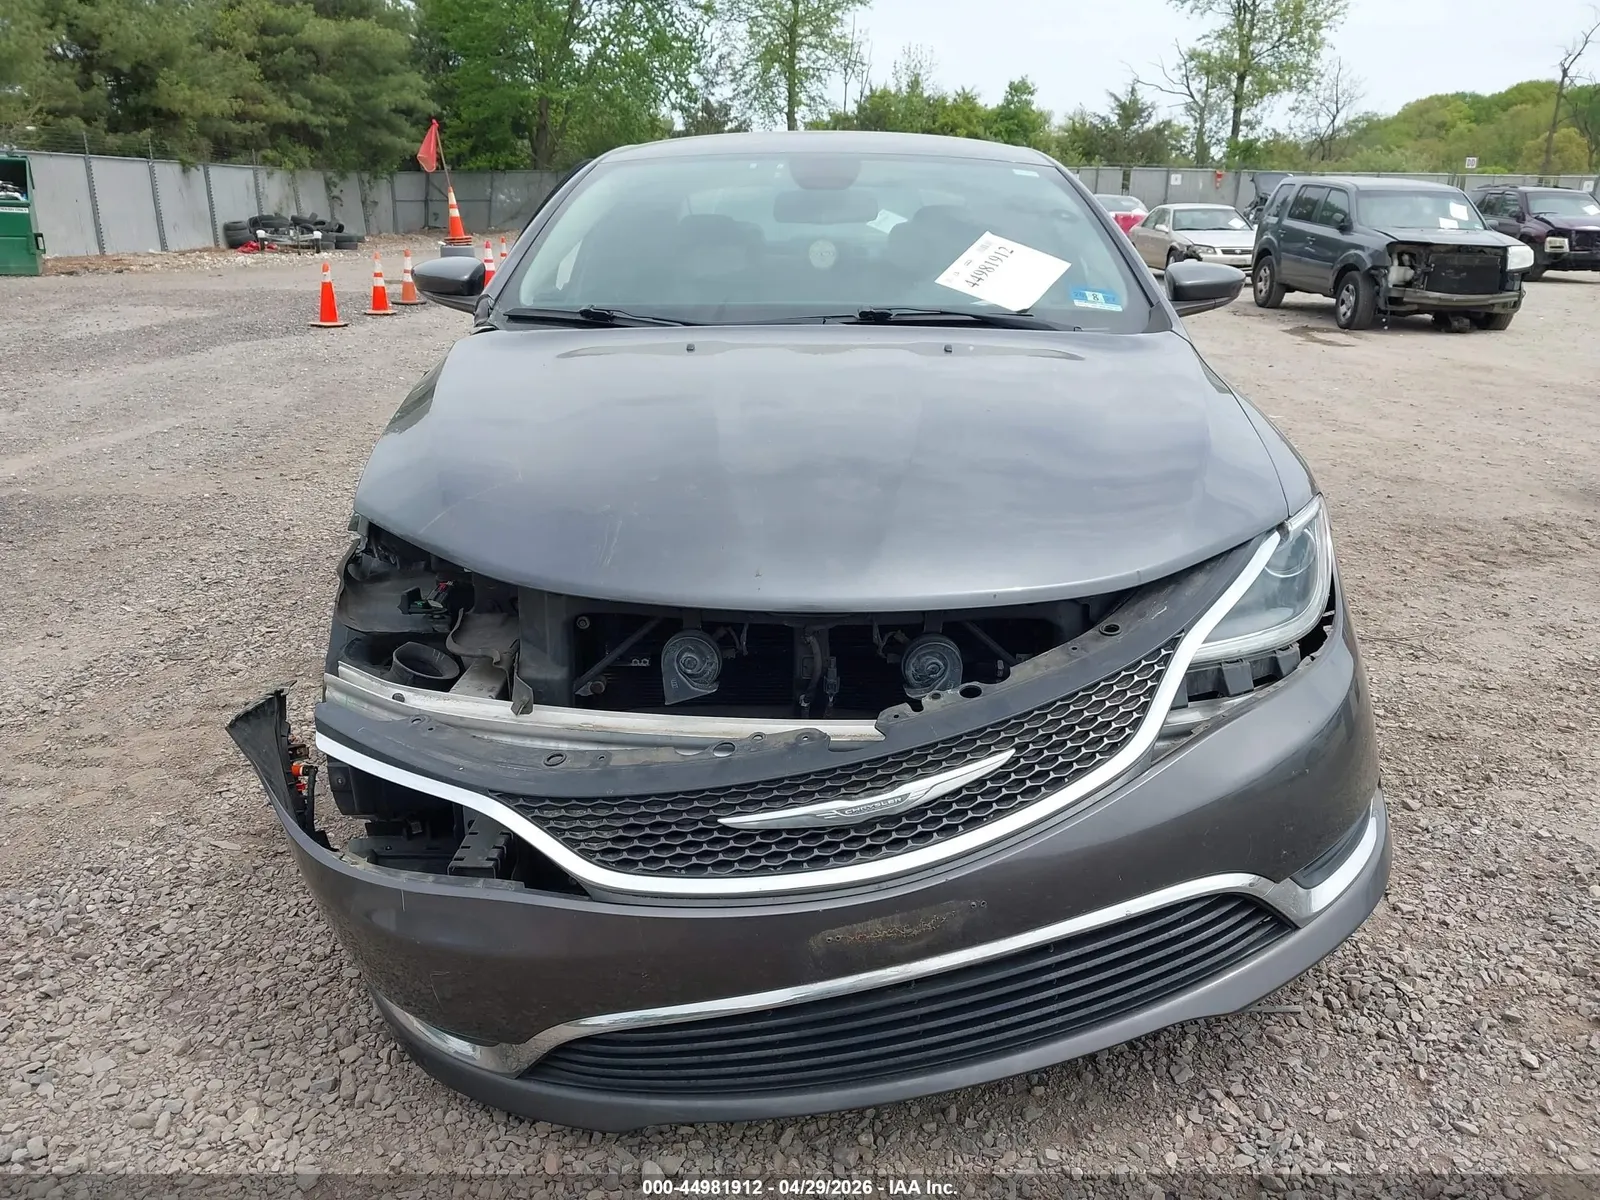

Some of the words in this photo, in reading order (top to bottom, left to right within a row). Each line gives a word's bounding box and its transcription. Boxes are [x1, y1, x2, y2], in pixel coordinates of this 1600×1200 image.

[965, 246, 1014, 287] 44981912
[1092, 293, 1099, 301] 8
[845, 797, 902, 814] CHRYSLER
